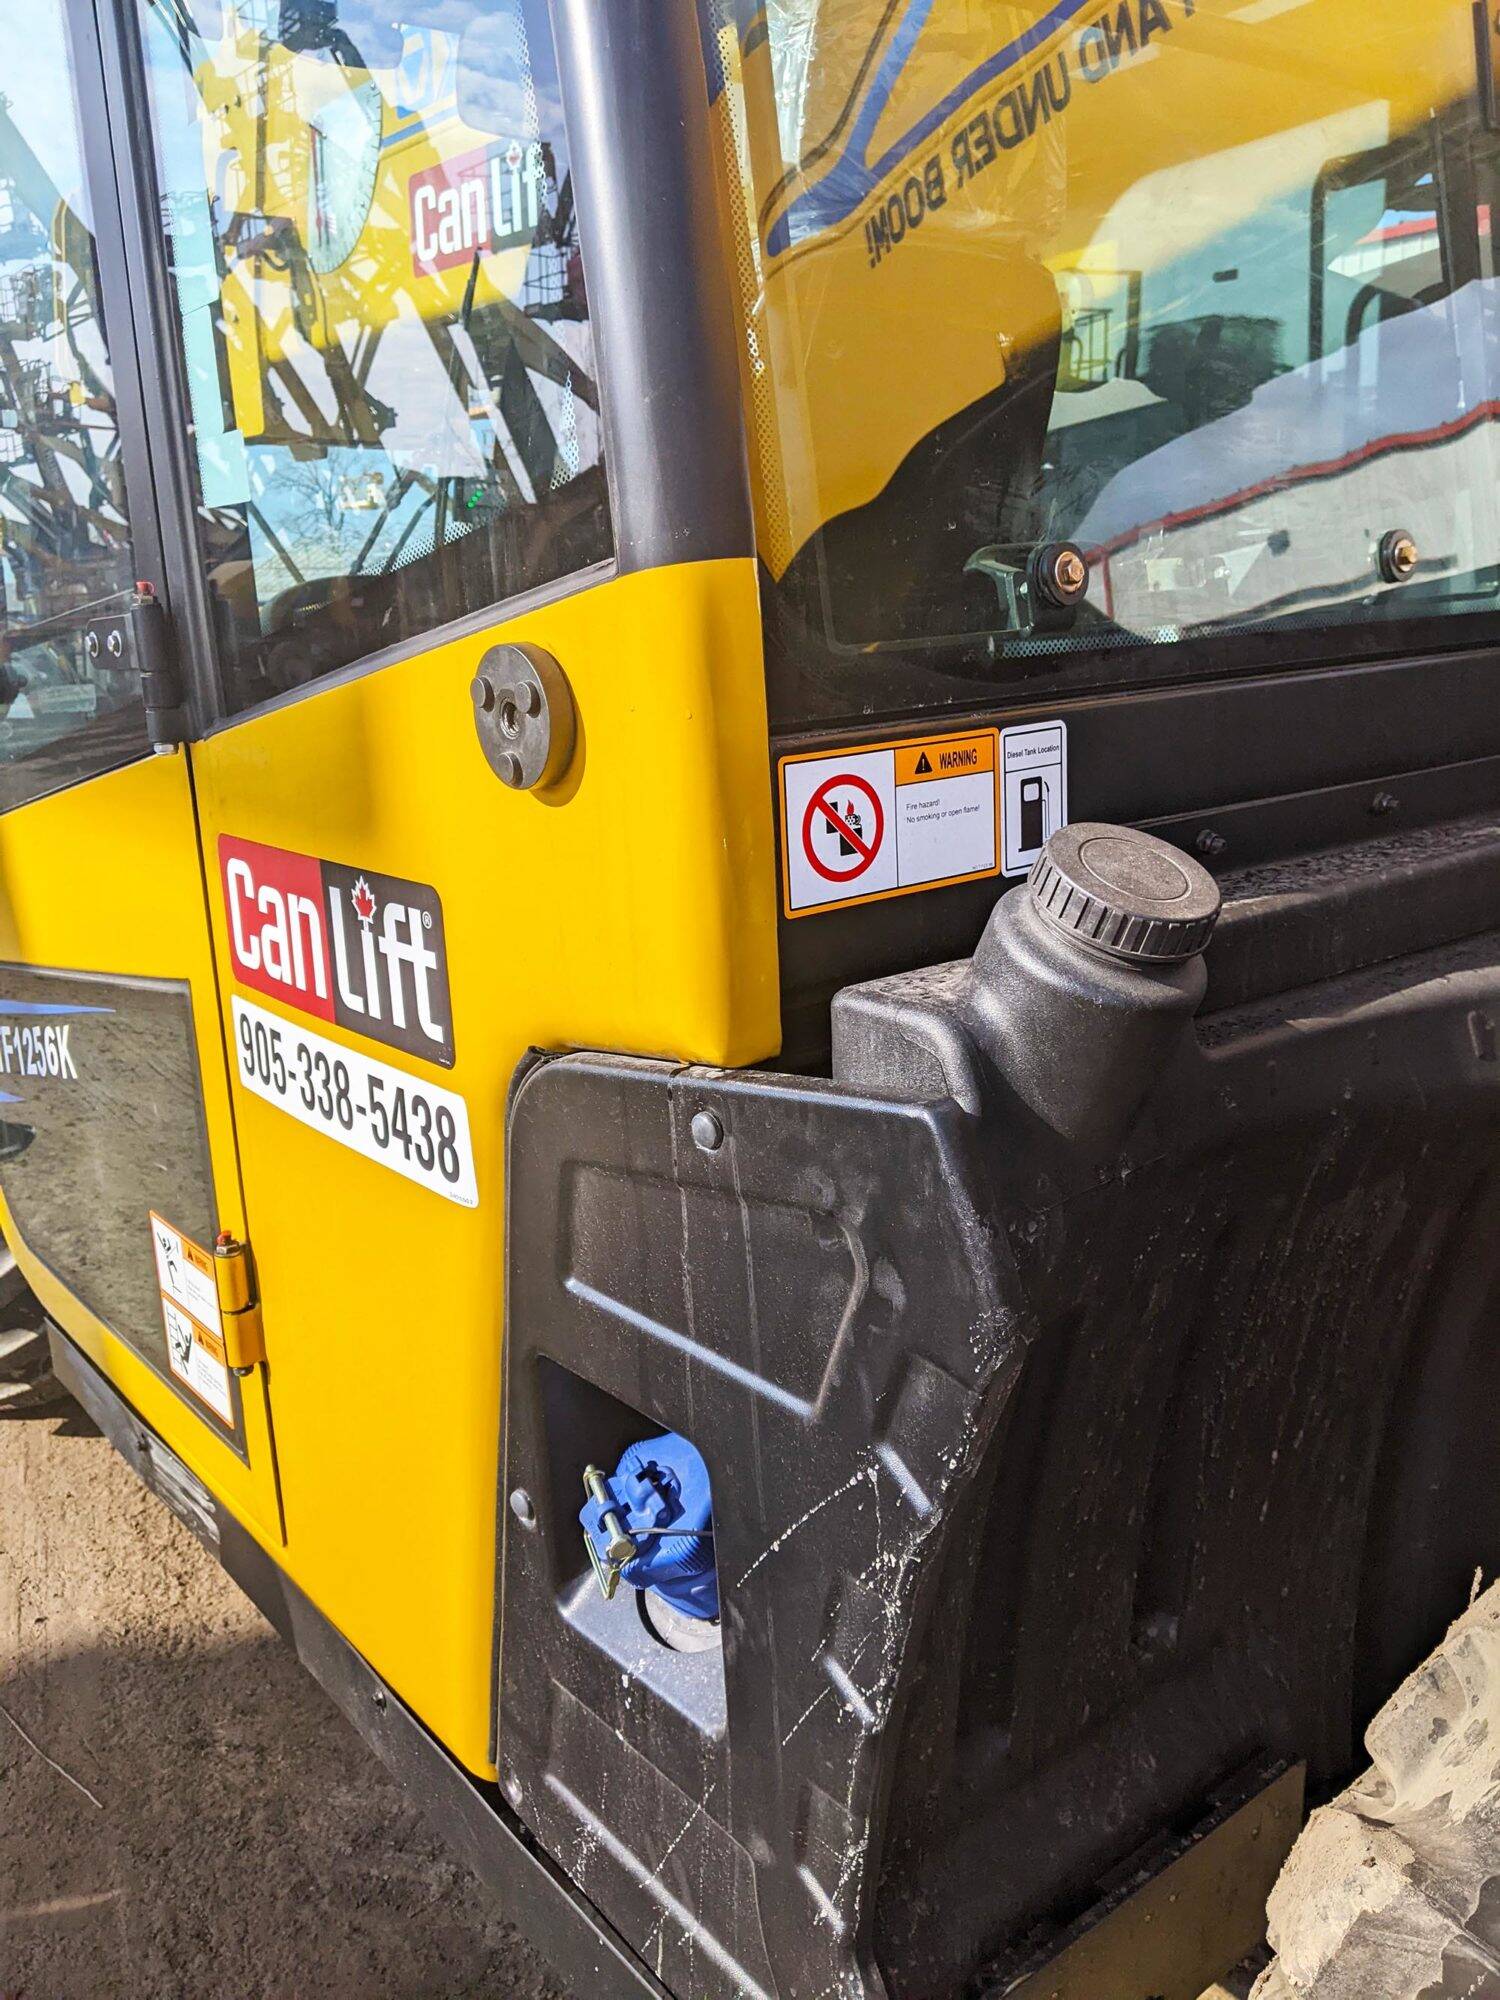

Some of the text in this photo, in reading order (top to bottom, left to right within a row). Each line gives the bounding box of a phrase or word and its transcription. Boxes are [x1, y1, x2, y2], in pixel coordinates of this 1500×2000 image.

[939, 748, 978, 770] WARNING
[1007, 744, 1060, 759] Diesel Tank Location
[905, 799, 941, 811] Fire hazard!
[906, 816, 916, 824] No
[916, 812, 940, 822] smoking
[948, 808, 963, 817] open
[962, 804, 981, 814] flame!
[239, 1013, 460, 1184] 905-338-5438
